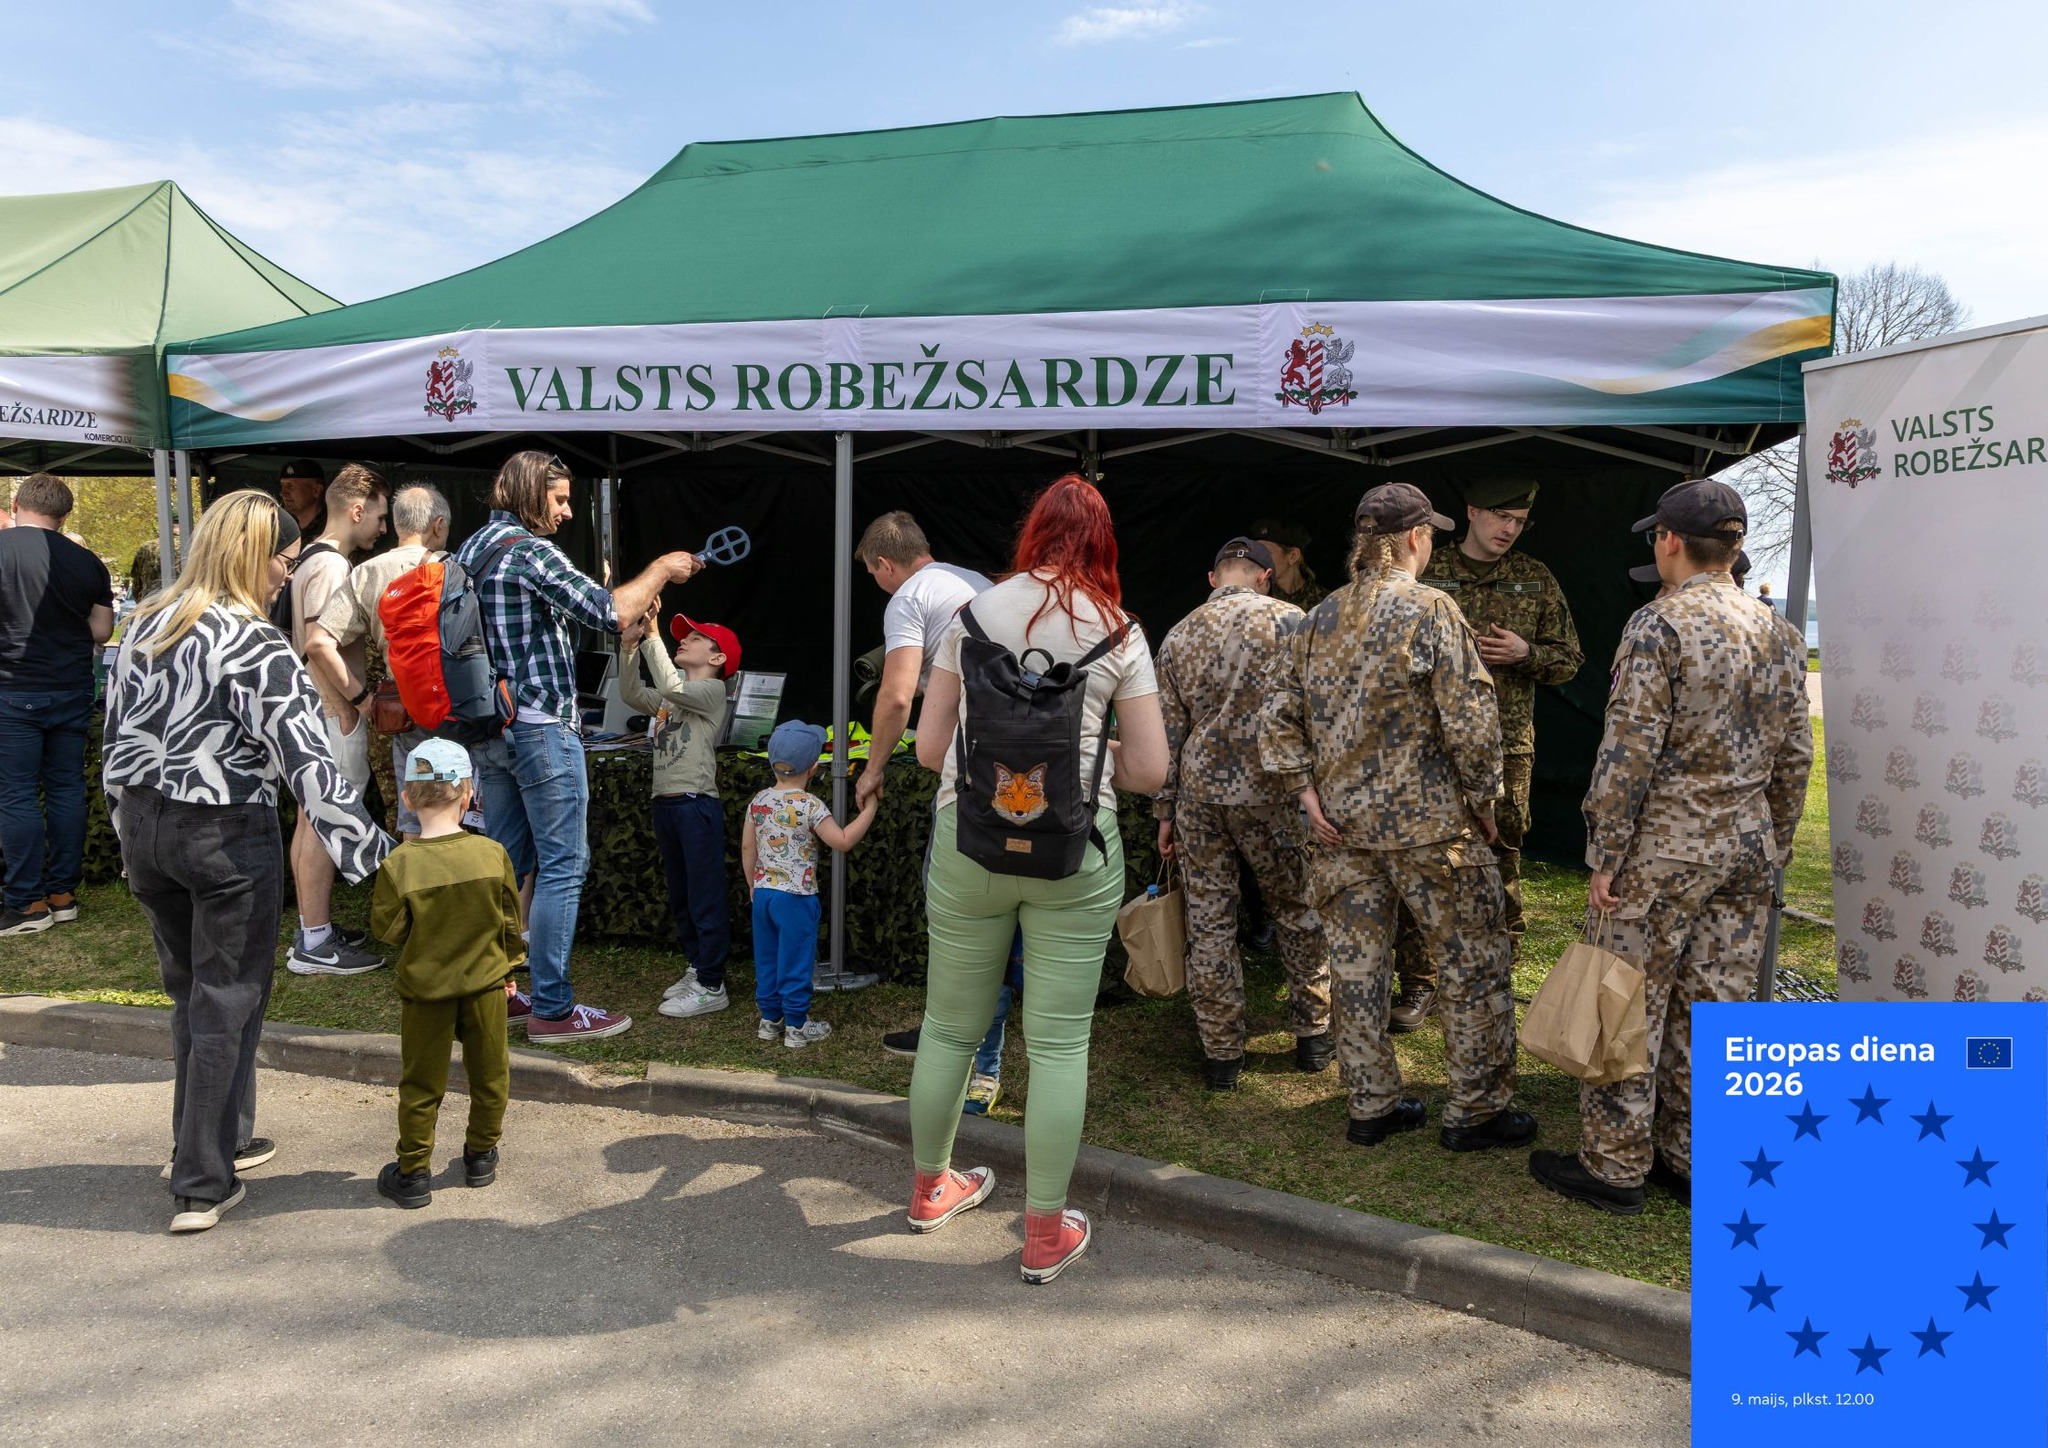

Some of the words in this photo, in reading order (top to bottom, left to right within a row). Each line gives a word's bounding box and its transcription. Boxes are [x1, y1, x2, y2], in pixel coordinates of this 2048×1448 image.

[505, 365, 714, 412] VALSTS
[731, 344, 1236, 411] ROBEŽSARDZE
[0, 401, 98, 429] EŽSARDZE
[1890, 405, 1995, 443] VALSTS
[84, 432, 132, 444] KOMERCIO.LV
[1894, 436, 2048, 478] ROBEŽSAR
